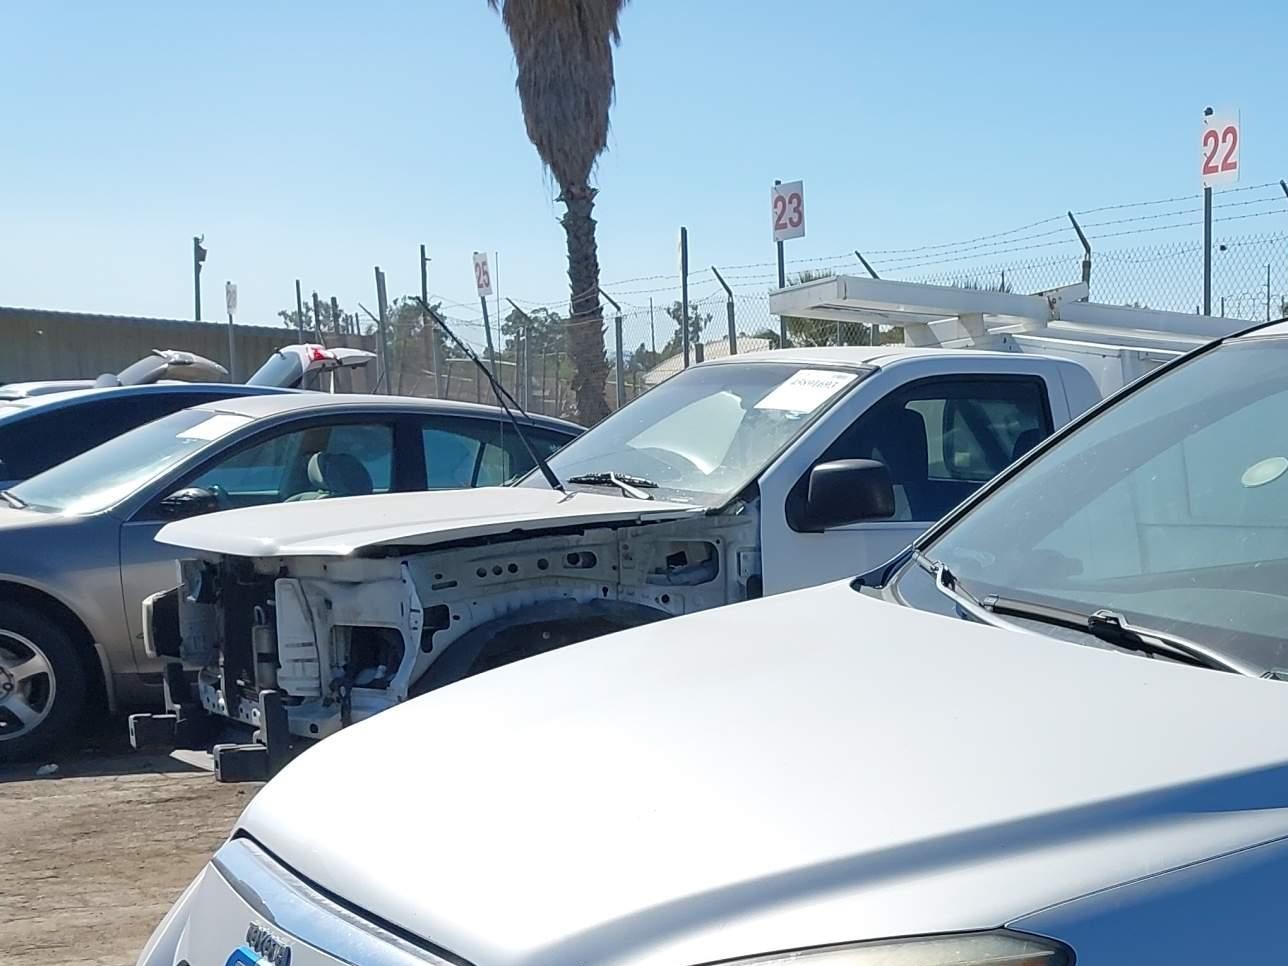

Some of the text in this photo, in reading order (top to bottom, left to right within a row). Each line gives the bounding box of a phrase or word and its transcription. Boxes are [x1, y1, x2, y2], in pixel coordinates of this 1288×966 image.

[1203, 126, 1238, 175] 22
[773, 193, 803, 231] 23
[474, 261, 490, 289] 25
